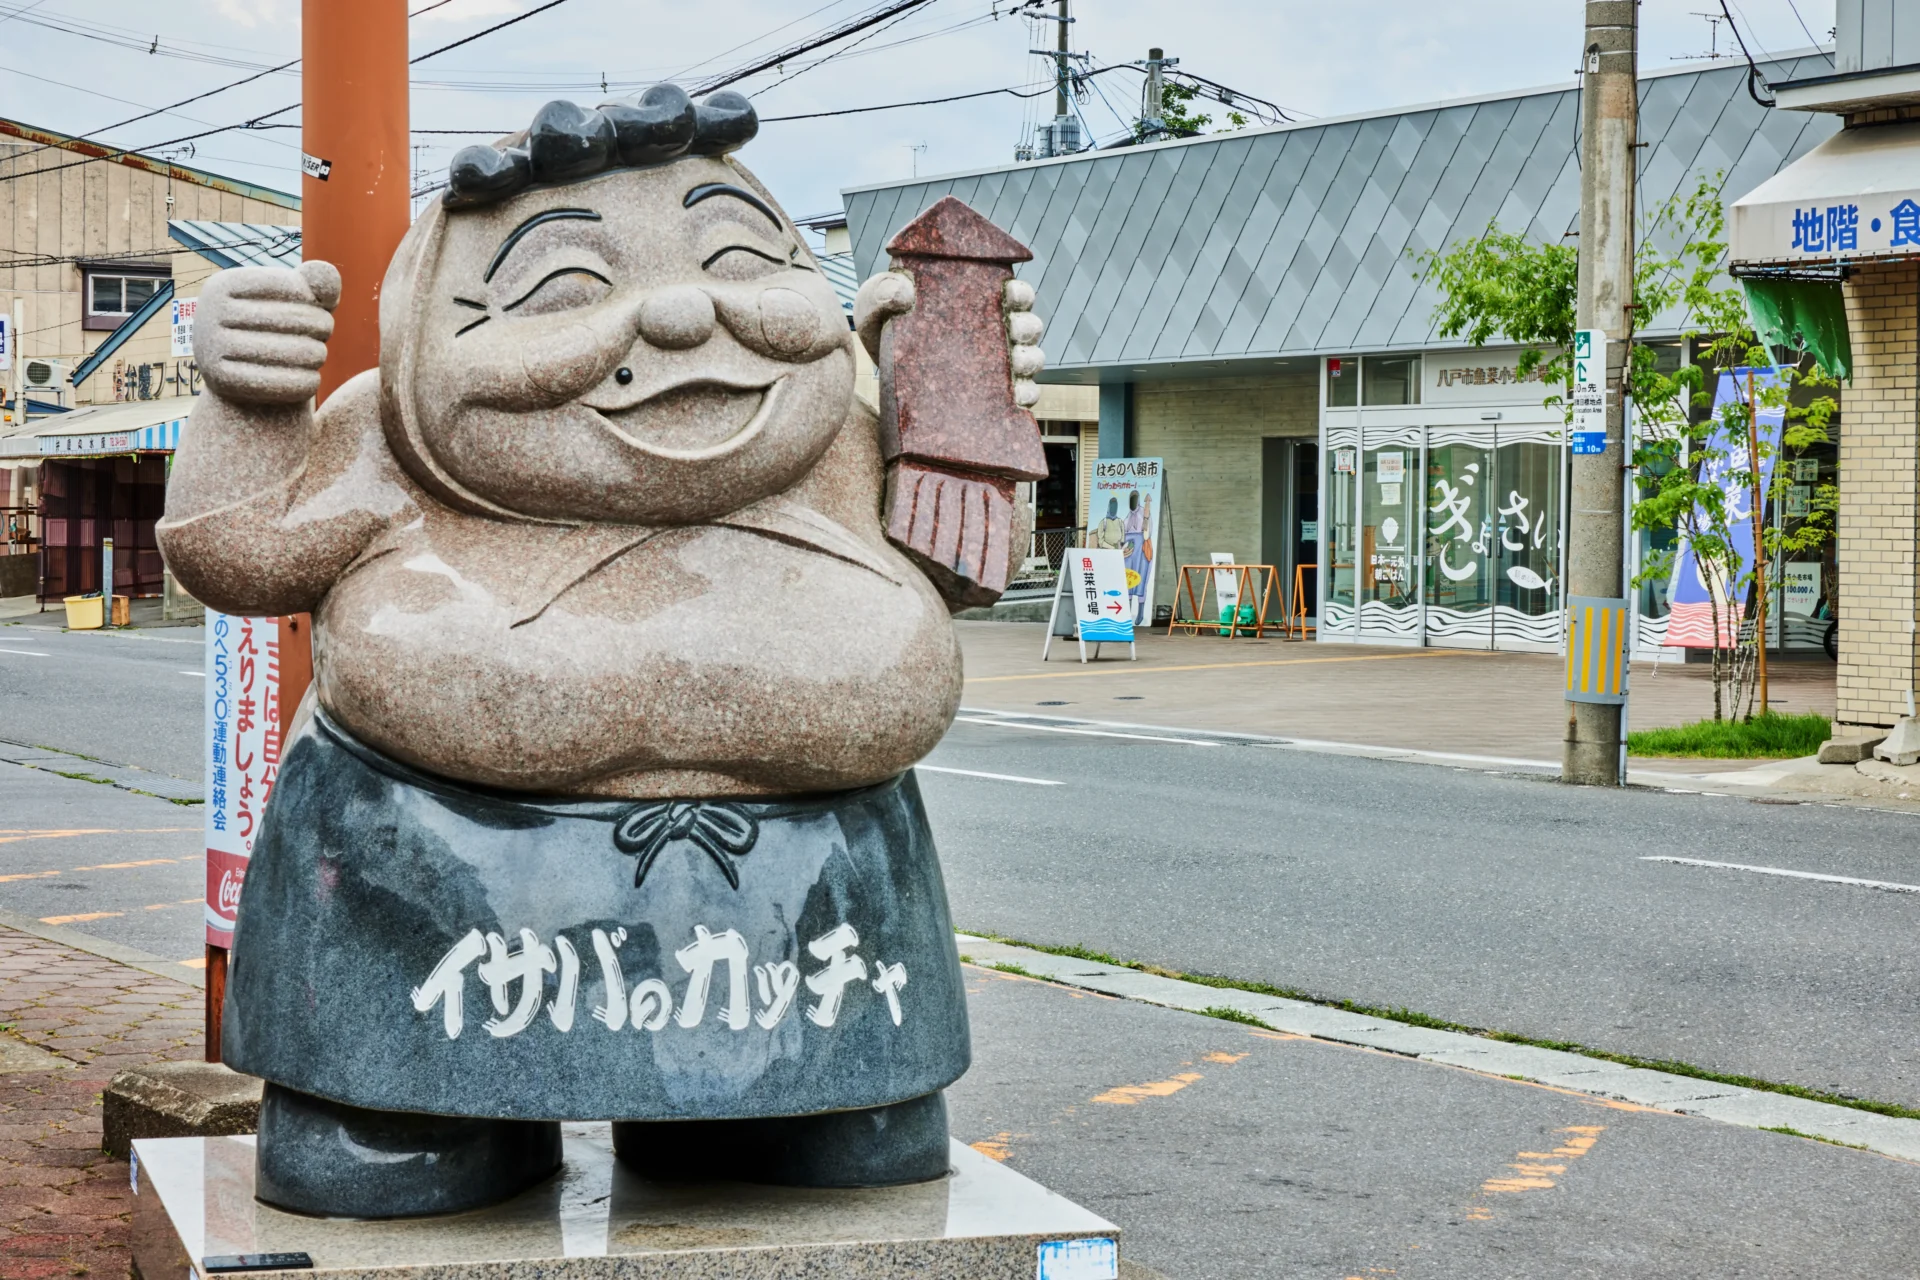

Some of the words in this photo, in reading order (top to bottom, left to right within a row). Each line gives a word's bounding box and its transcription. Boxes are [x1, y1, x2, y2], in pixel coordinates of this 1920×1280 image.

[1791, 198, 1920, 252] 地階・食
[1096, 461, 1159, 478] はちのへ朝市
[1587, 445, 1601, 453] 10m
[1082, 557, 1100, 616] 魚菜市場
[1374, 568, 1405, 581] 朝ごはん
[211, 614, 230, 832] のへ530運動連絡会
[236, 616, 259, 851] えりましょう。
[409, 922, 908, 1039] イサバのカッチャ
